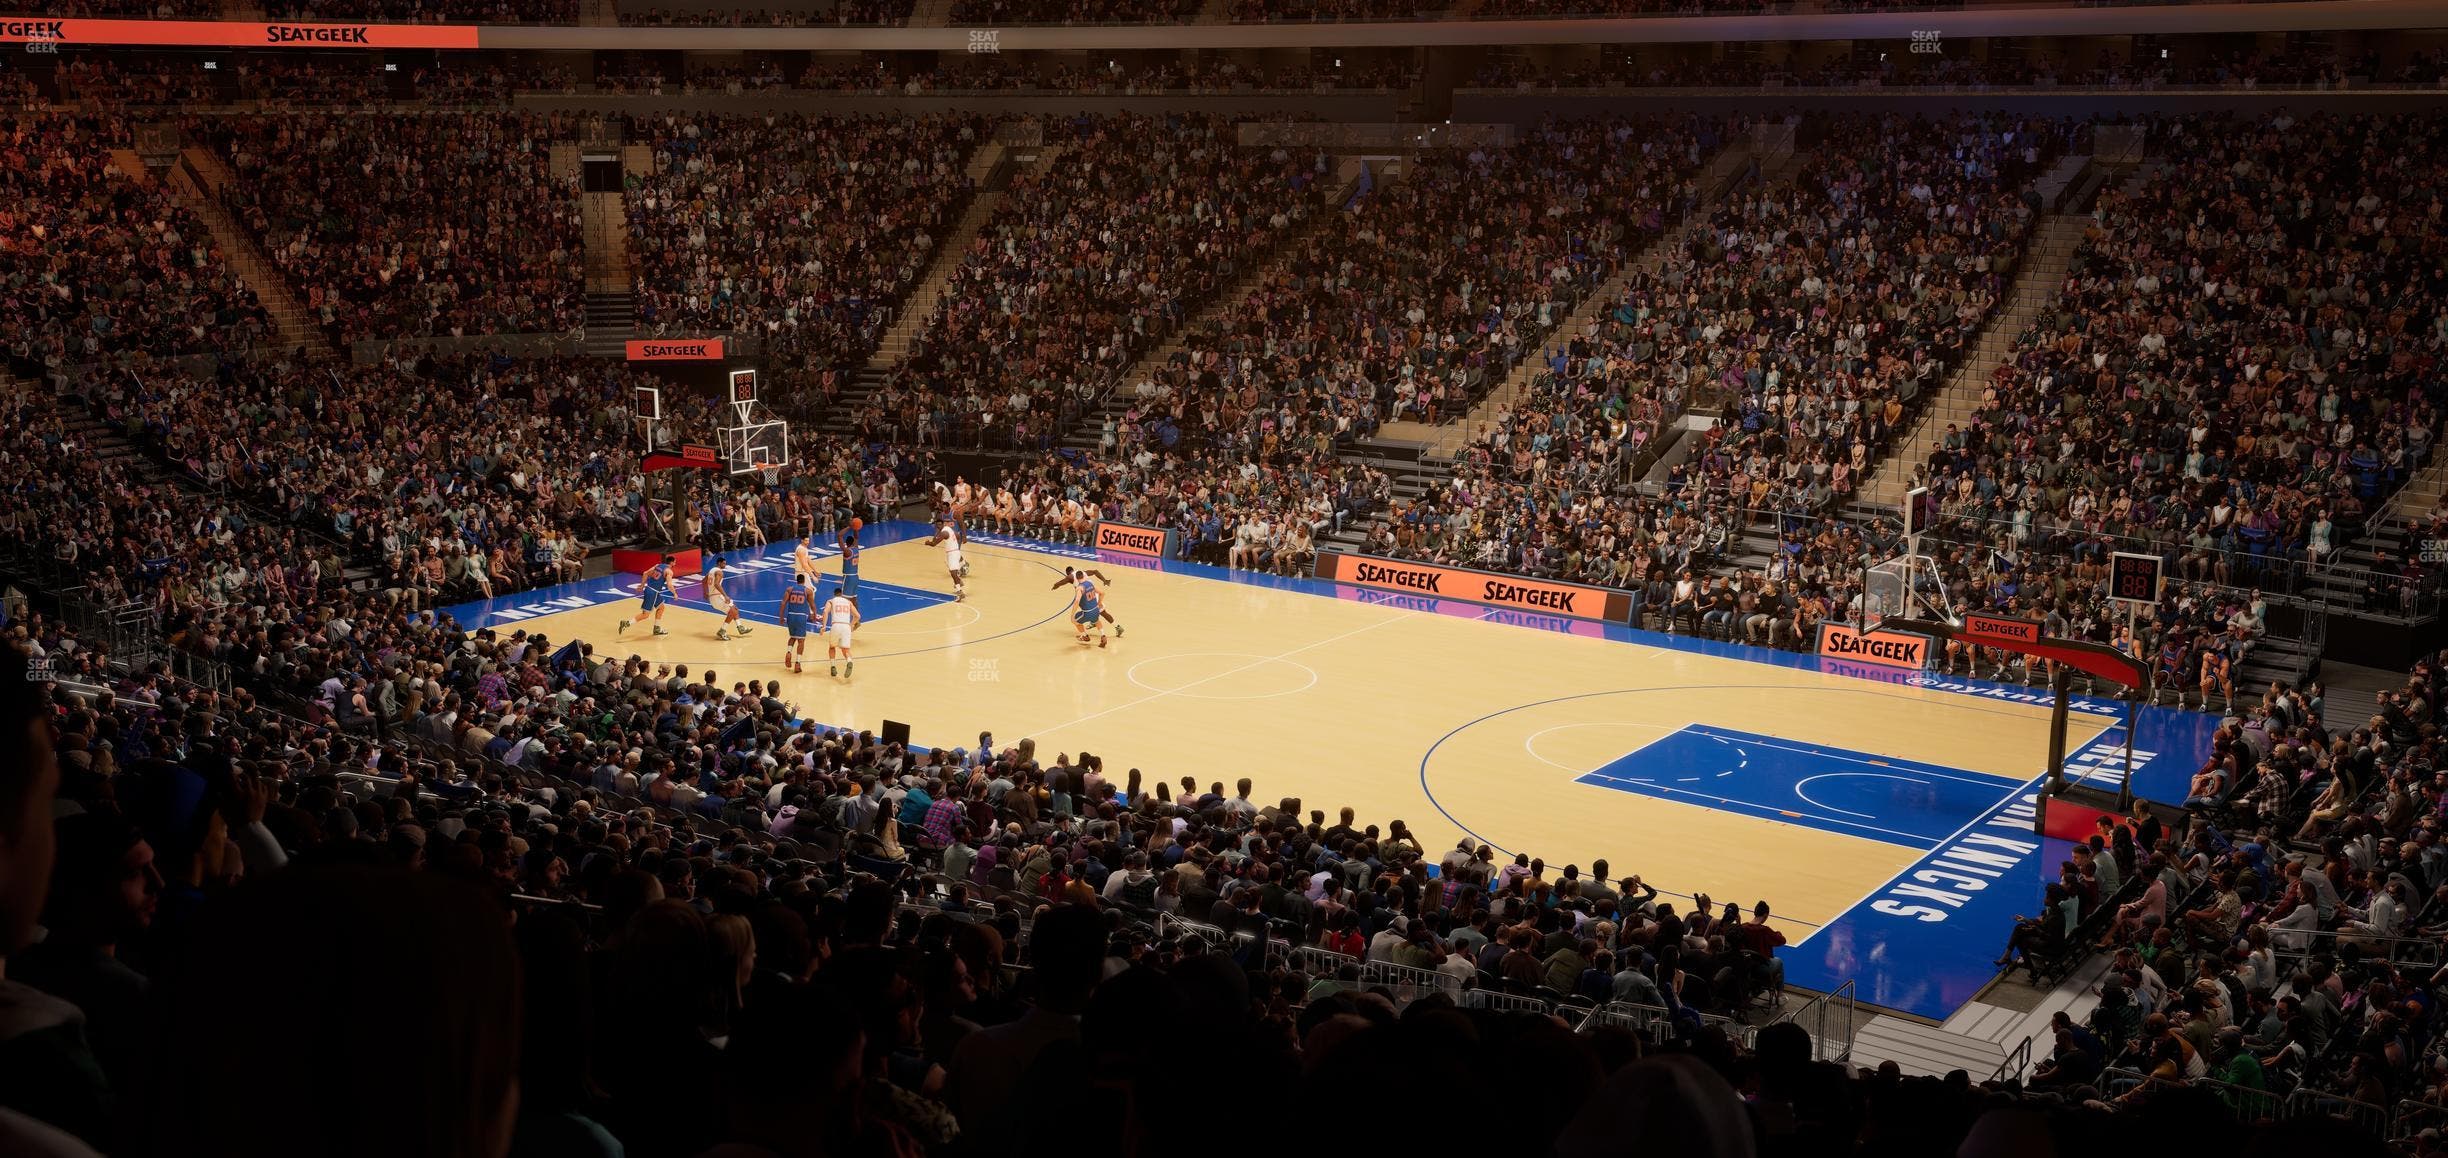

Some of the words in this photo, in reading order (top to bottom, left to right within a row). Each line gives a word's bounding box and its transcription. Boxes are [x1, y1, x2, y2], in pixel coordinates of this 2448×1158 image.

[267, 26, 369, 44] SEATGEEK
[643, 345, 707, 357] SEATGEEK
[1101, 528, 1160, 552] SEATGEEK
[790, 594, 805, 604] 00
[1356, 563, 1442, 593] SEATGEEK
[1483, 581, 1576, 613] SEATGEEK
[490, 595, 596, 620] NEW
[1974, 620, 2029, 638] SEATGEEK
[1828, 632, 1920, 664] SEATGEEK
[2064, 743, 2159, 785] NEW
[1869, 832, 2040, 922] KNICKS
